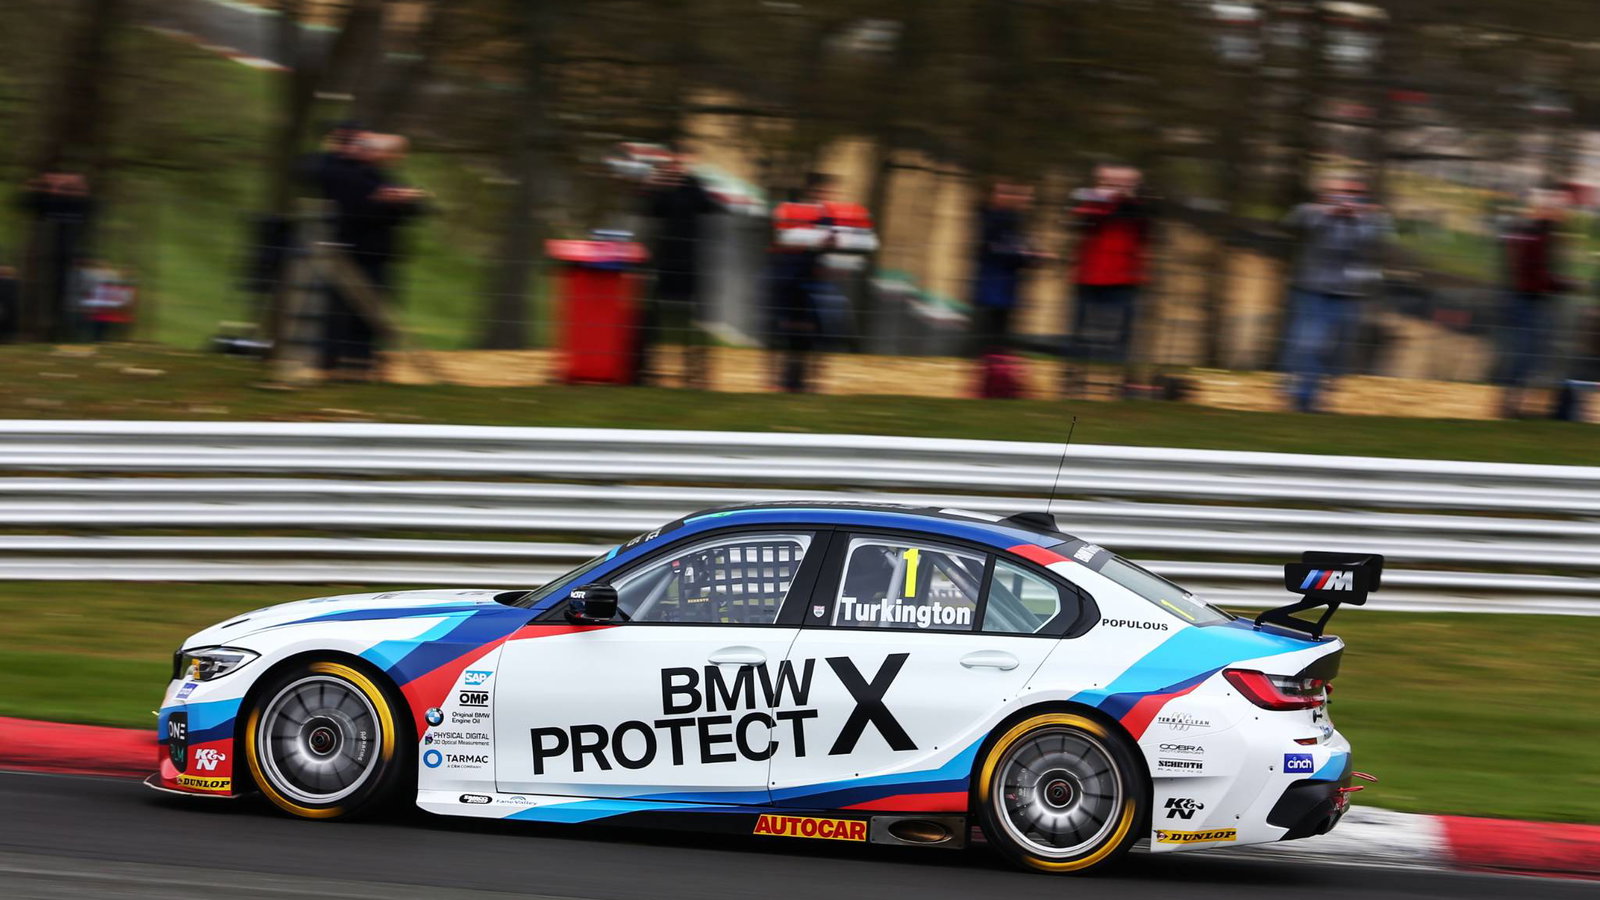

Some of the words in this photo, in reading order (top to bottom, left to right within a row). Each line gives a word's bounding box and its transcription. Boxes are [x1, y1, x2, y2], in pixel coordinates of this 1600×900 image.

[903, 548, 919, 598] 1
[840, 597, 971, 628] Turkington
[1102, 617, 1169, 631] POPULOUS
[465, 672, 487, 684] SAP
[660, 658, 816, 716] BMW
[459, 693, 489, 705] OMP
[824, 652, 919, 756] X
[452, 711, 473, 719] Original
[168, 721, 186, 740] ONE
[433, 732, 464, 740] PHYSICAL
[465, 732, 490, 740] DIGITAL
[530, 709, 819, 775] PROTECT
[1159, 743, 1205, 752] COBRA
[446, 754, 489, 764] TARMAC
[1158, 760, 1203, 769] SCHROTH
[1287, 756, 1313, 769] cinch
[183, 777, 231, 788] DUNLOP
[754, 815, 866, 841] AUTOCAR
[1169, 829, 1237, 842] DUNLOP
